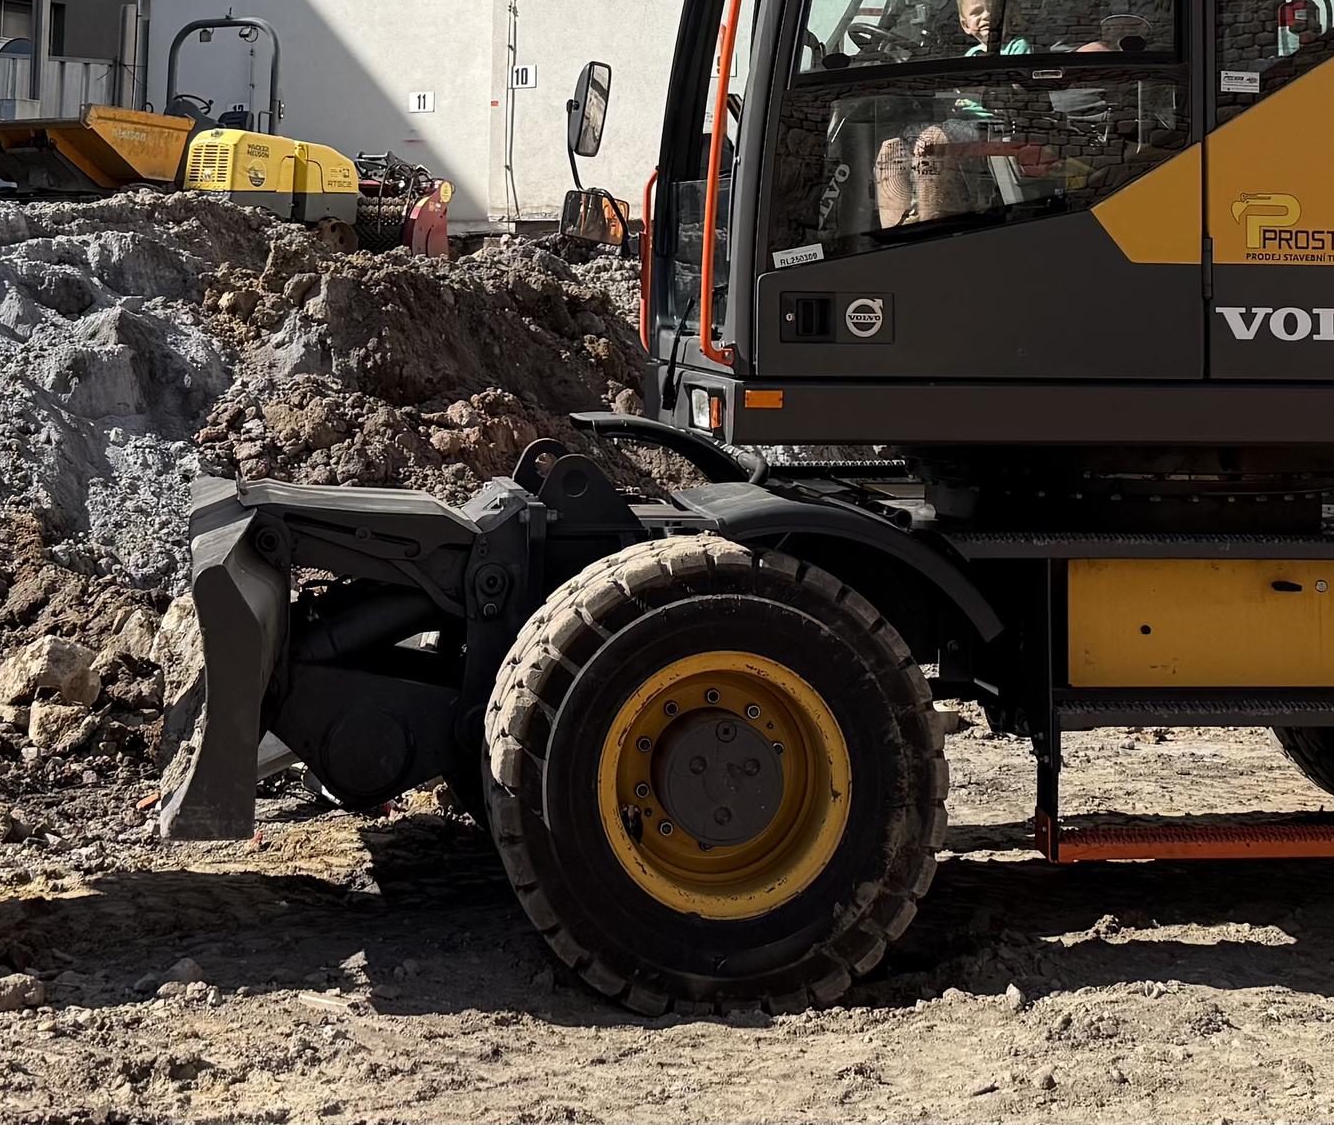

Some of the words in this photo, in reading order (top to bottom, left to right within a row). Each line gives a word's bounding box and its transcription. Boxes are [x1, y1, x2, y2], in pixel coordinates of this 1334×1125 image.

[514, 67, 528, 86] 10
[417, 94, 427, 110] 11
[817, 164, 851, 230] LVO
[1246, 252, 1281, 261] PRODEJ
[1283, 253, 1326, 262] STAVEBNÍ
